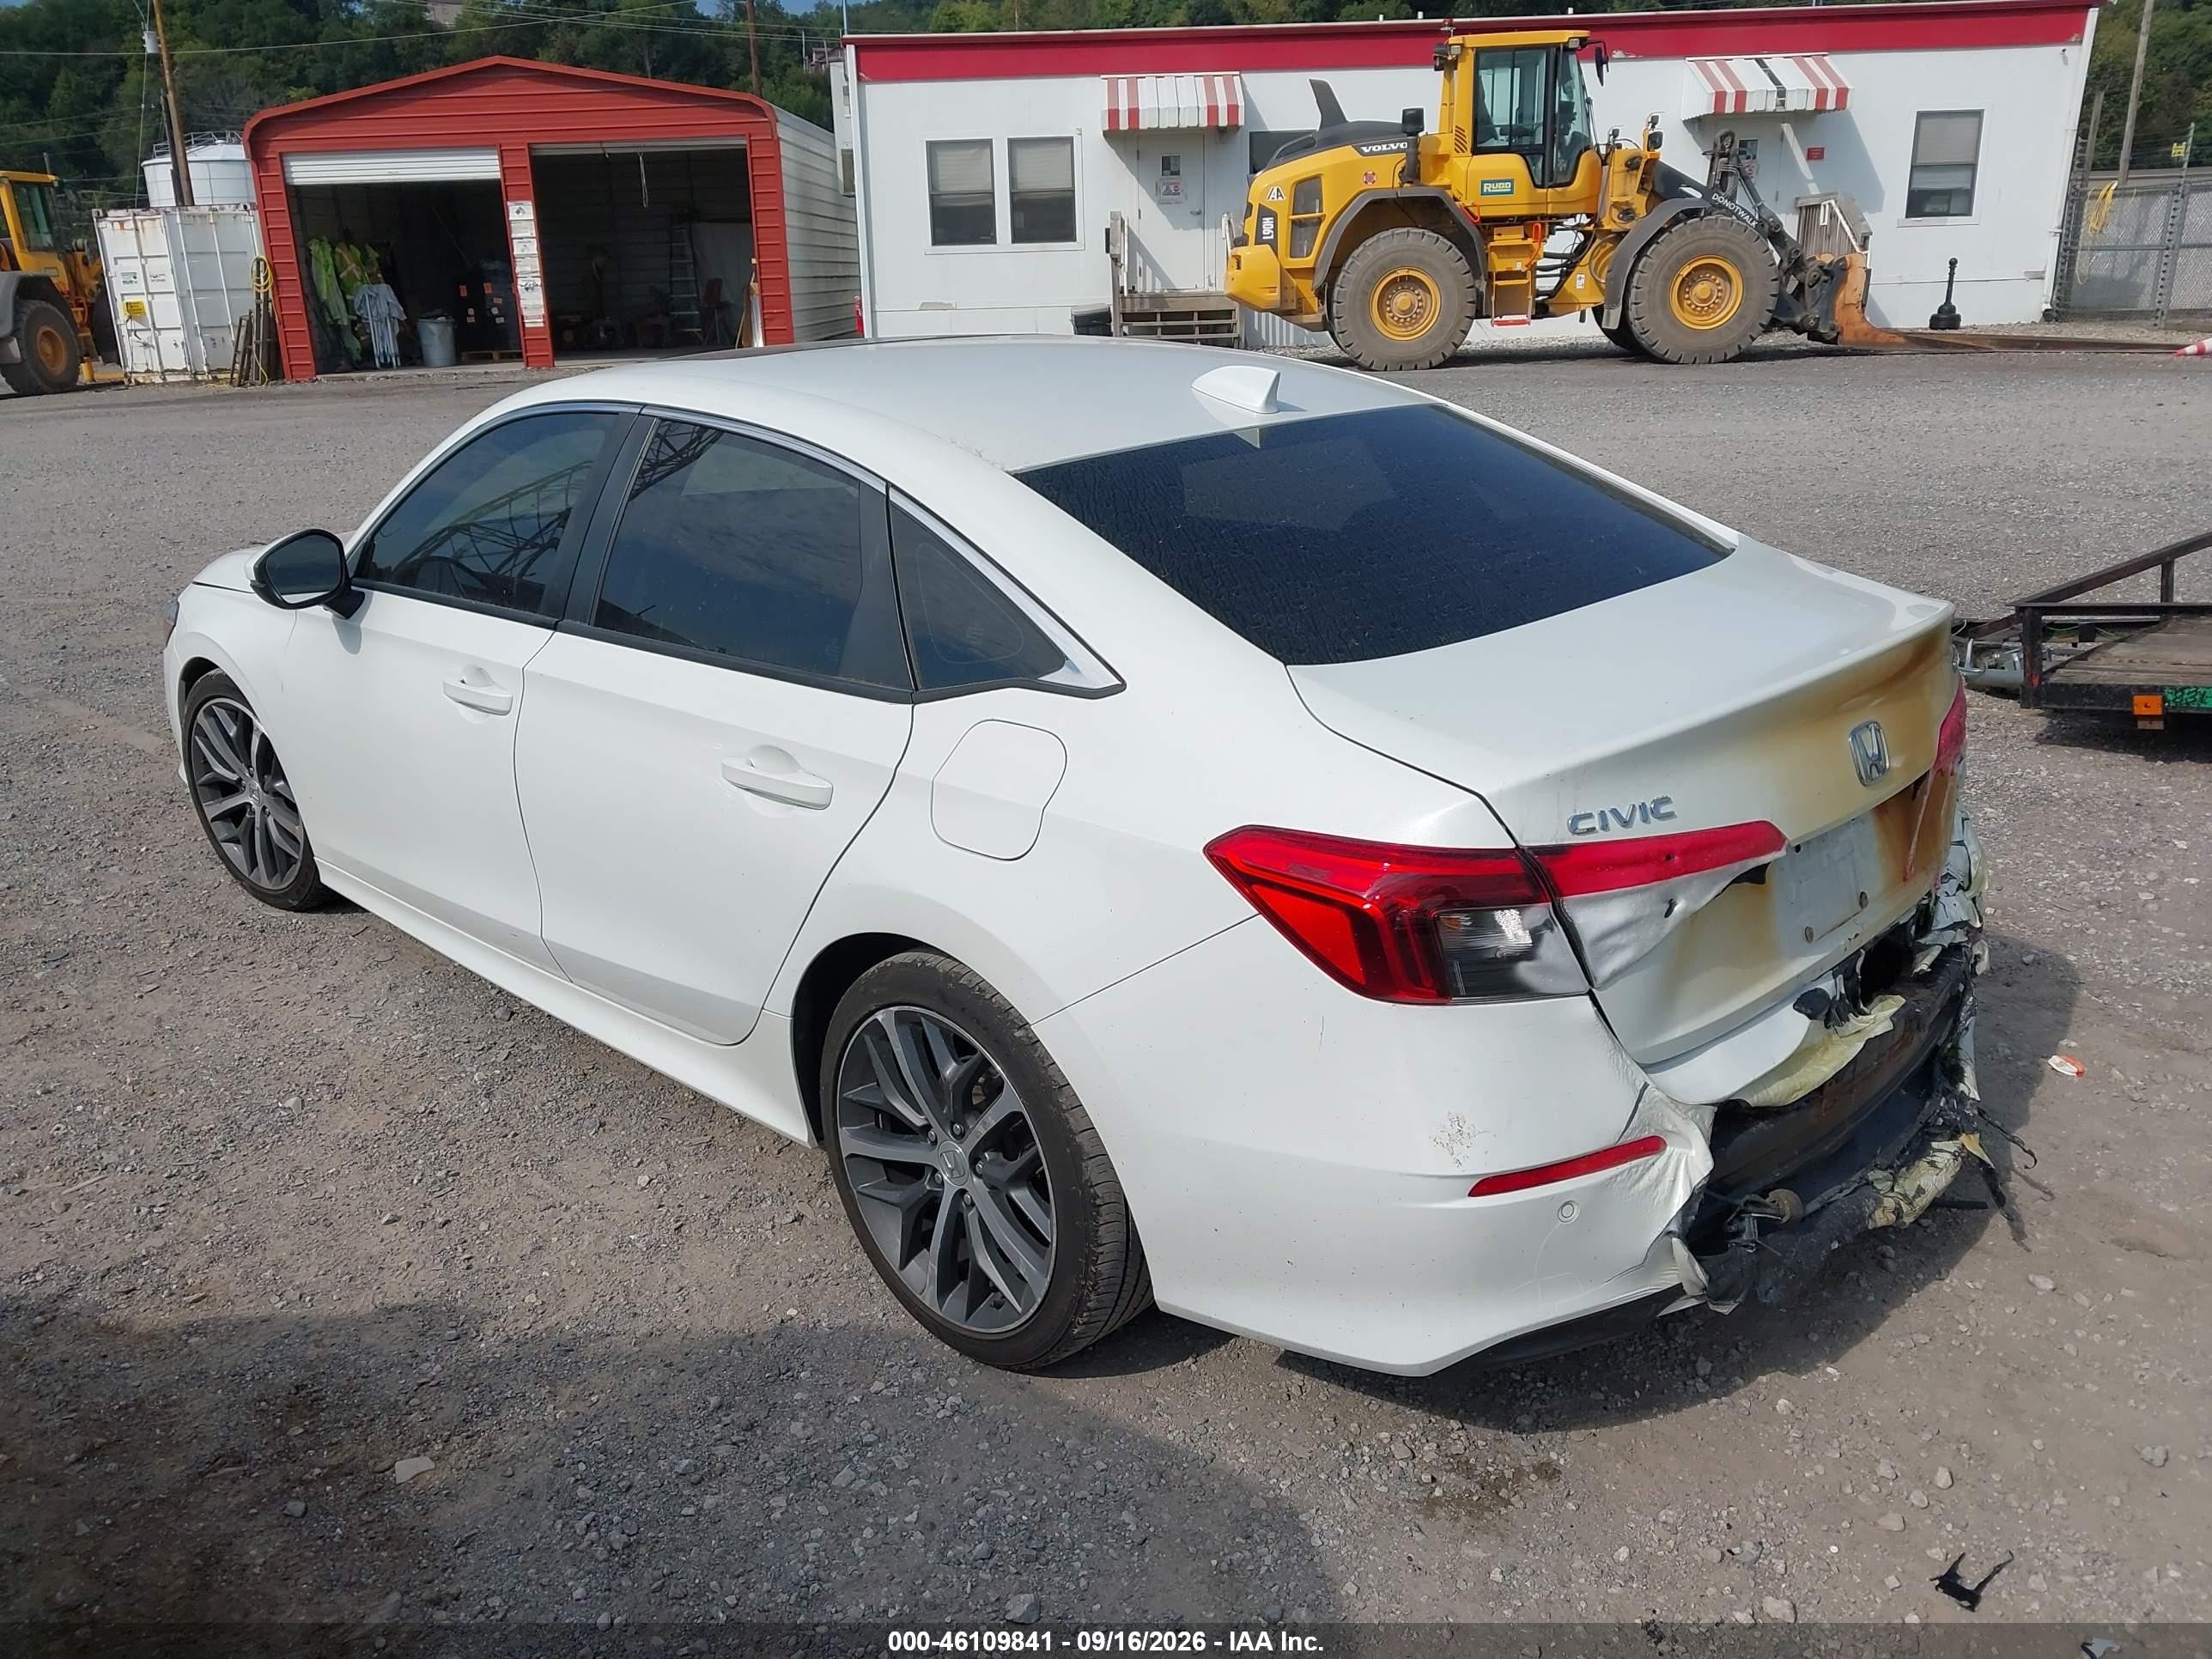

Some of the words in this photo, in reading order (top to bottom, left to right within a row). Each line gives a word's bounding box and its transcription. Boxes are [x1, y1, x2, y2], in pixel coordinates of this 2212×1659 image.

[1483, 181, 1512, 193] RUDD
[1262, 216, 1274, 240] L90H
[1567, 795, 1677, 836] CIVIC
